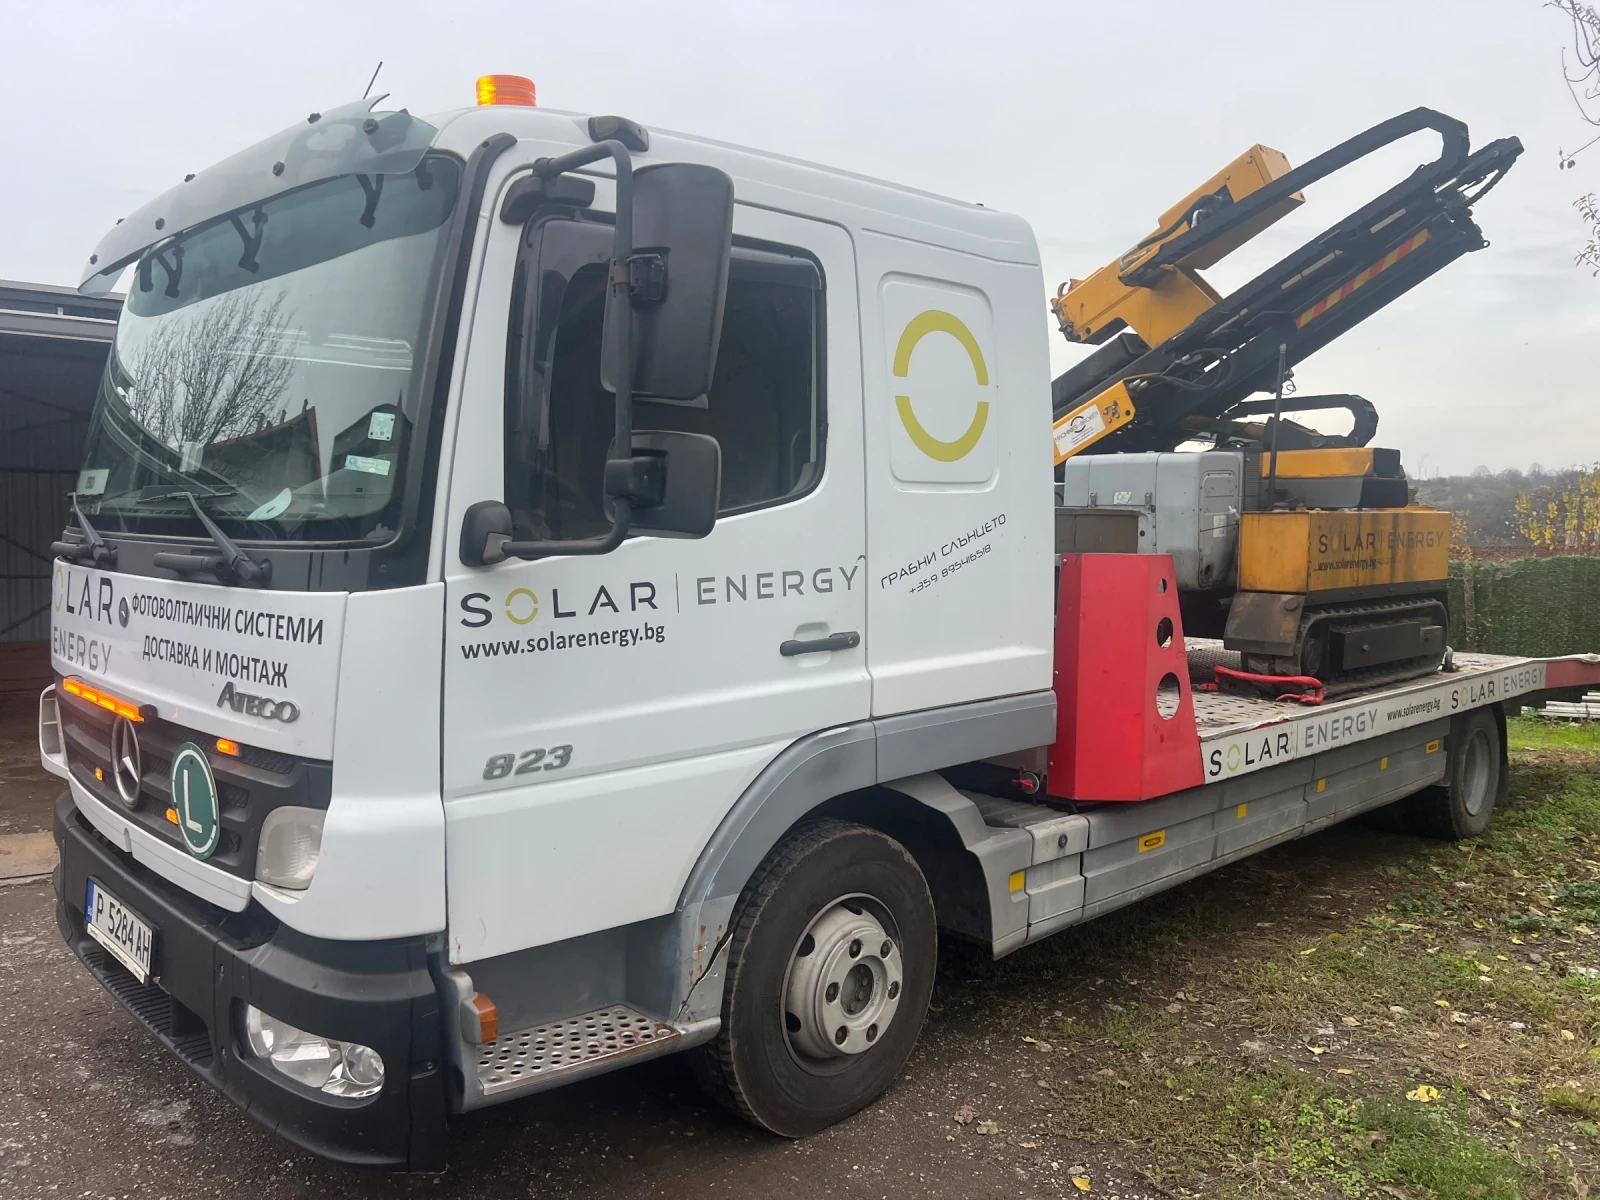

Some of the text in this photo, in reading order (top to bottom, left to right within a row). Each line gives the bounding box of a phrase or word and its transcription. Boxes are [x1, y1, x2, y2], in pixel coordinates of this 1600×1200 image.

[880, 513, 1006, 589] ГРАБНИ СЛЪНЦЕТО
[1318, 530, 1444, 554] SOLAR ENERGY
[909, 544, 991, 594] +359 895416518
[132, 592, 324, 645] ФОТОВОЛТАИЧНИ СИСТЕМИ
[460, 565, 859, 628] SOLAR ENERGY
[53, 625, 112, 675] ENERGY
[142, 634, 288, 689] ДОСТАВКА И МОНТАЖ
[461, 622, 666, 660] www.solarenergy.bg
[1386, 697, 1441, 721] www.solarenergy.bg
[1450, 666, 1545, 710] SOLAR ENERGY
[482, 744, 573, 781] 823
[1208, 708, 1378, 777] SOLAR ENERGY
[182, 768, 203, 834] L
[96, 892, 104, 923] P
[108, 901, 135, 953] 5284
[135, 924, 151, 969] AH
